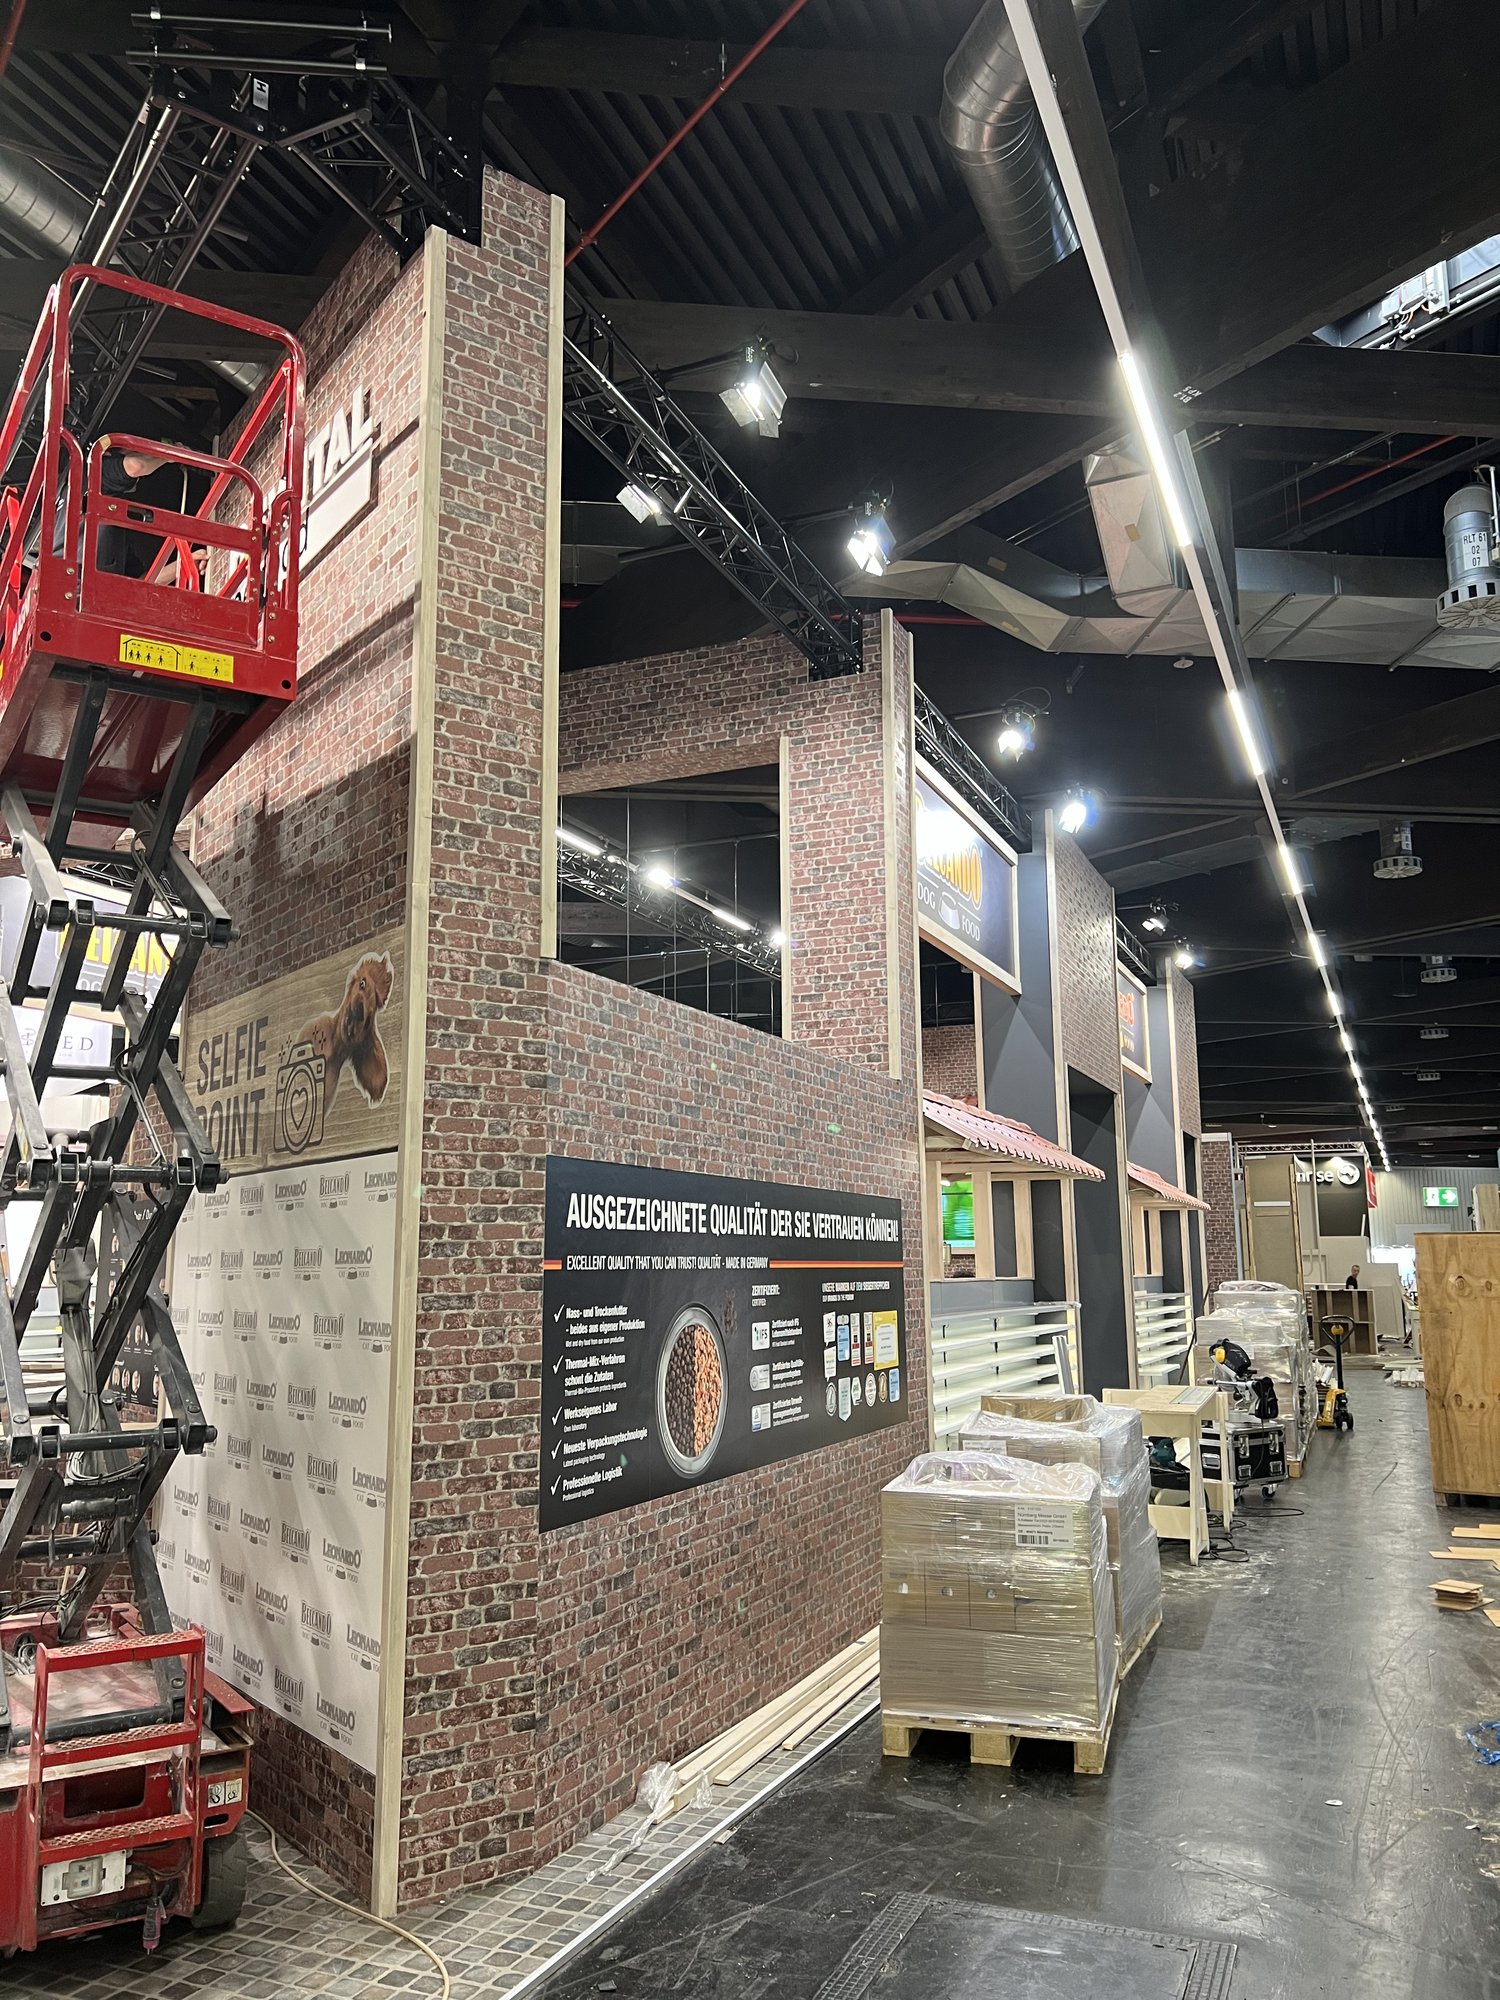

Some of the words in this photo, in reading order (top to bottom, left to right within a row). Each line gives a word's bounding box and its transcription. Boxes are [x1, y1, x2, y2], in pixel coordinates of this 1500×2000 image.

[1463, 533, 1476, 544] RLT
[1478, 532, 1487, 542] 61
[1471, 545, 1481, 555] 02
[1472, 557, 1481, 567] 07
[917, 882, 936, 909] DOG
[962, 915, 981, 941] FOOD
[197, 1016, 268, 1095] SELFIE
[320, 1174, 349, 1195] BELCANDO
[364, 1171, 397, 1189] LEONARD
[566, 1192, 707, 1233] AUSGEZEICHNETE
[710, 1201, 768, 1237] QUALITÄT
[770, 1209, 792, 1237] DER
[794, 1211, 811, 1238] SIE
[812, 1213, 864, 1240] VERTRAUEN
[865, 1213, 899, 1242] KÖNNEN!
[335, 1246, 372, 1265] LEONARDO
[567, 1255, 607, 1270] EXCELLENT
[607, 1255, 634, 1270] QUALITY
[635, 1255, 650, 1270] THAT
[651, 1255, 664, 1270] YOU
[664, 1256, 677, 1270] CAN
[677, 1256, 697, 1269] TRUST!
[697, 1254, 721, 1269] QUALITÄT
[726, 1257, 740, 1269] MADE
[740, 1257, 746, 1269] IN
[747, 1257, 768, 1269] GERMANY
[583, 1306, 594, 1318] und
[313, 1314, 343, 1336] BELCANDO
[358, 1317, 392, 1337] LEONARD
[569, 1323, 588, 1335] beides
[589, 1324, 599, 1333] aus
[600, 1321, 619, 1334] eigener
[619, 1319, 645, 1331] Produktion
[565, 1353, 626, 1370] Thermal-Mix-Verfahren
[564, 1373, 584, 1387] schont
[584, 1372, 593, 1384] die
[594, 1370, 614, 1383] Zutaten
[288, 1385, 316, 1408] BELCANDO
[329, 1392, 366, 1415] LEONARDO
[564, 1405, 602, 1420] Werkseigenes
[602, 1401, 618, 1414] Labor
[563, 1440, 586, 1455] Neueste
[586, 1427, 648, 1450] Verpackungstechnologie
[307, 1455, 337, 1482] BELCANDO
[352, 1467, 386, 1493] LEONARD
[563, 1471, 602, 1491] Professionelle
[602, 1466, 623, 1482] Logistik
[282, 1523, 310, 1552] BELCANDO
[323, 1538, 361, 1569] LEONARDO
[301, 1603, 332, 1635] BELCANDO
[347, 1623, 380, 1657] LEONARD
[275, 1668, 303, 1703] BELCANDO
[316, 1692, 355, 1731] LEONARDO
